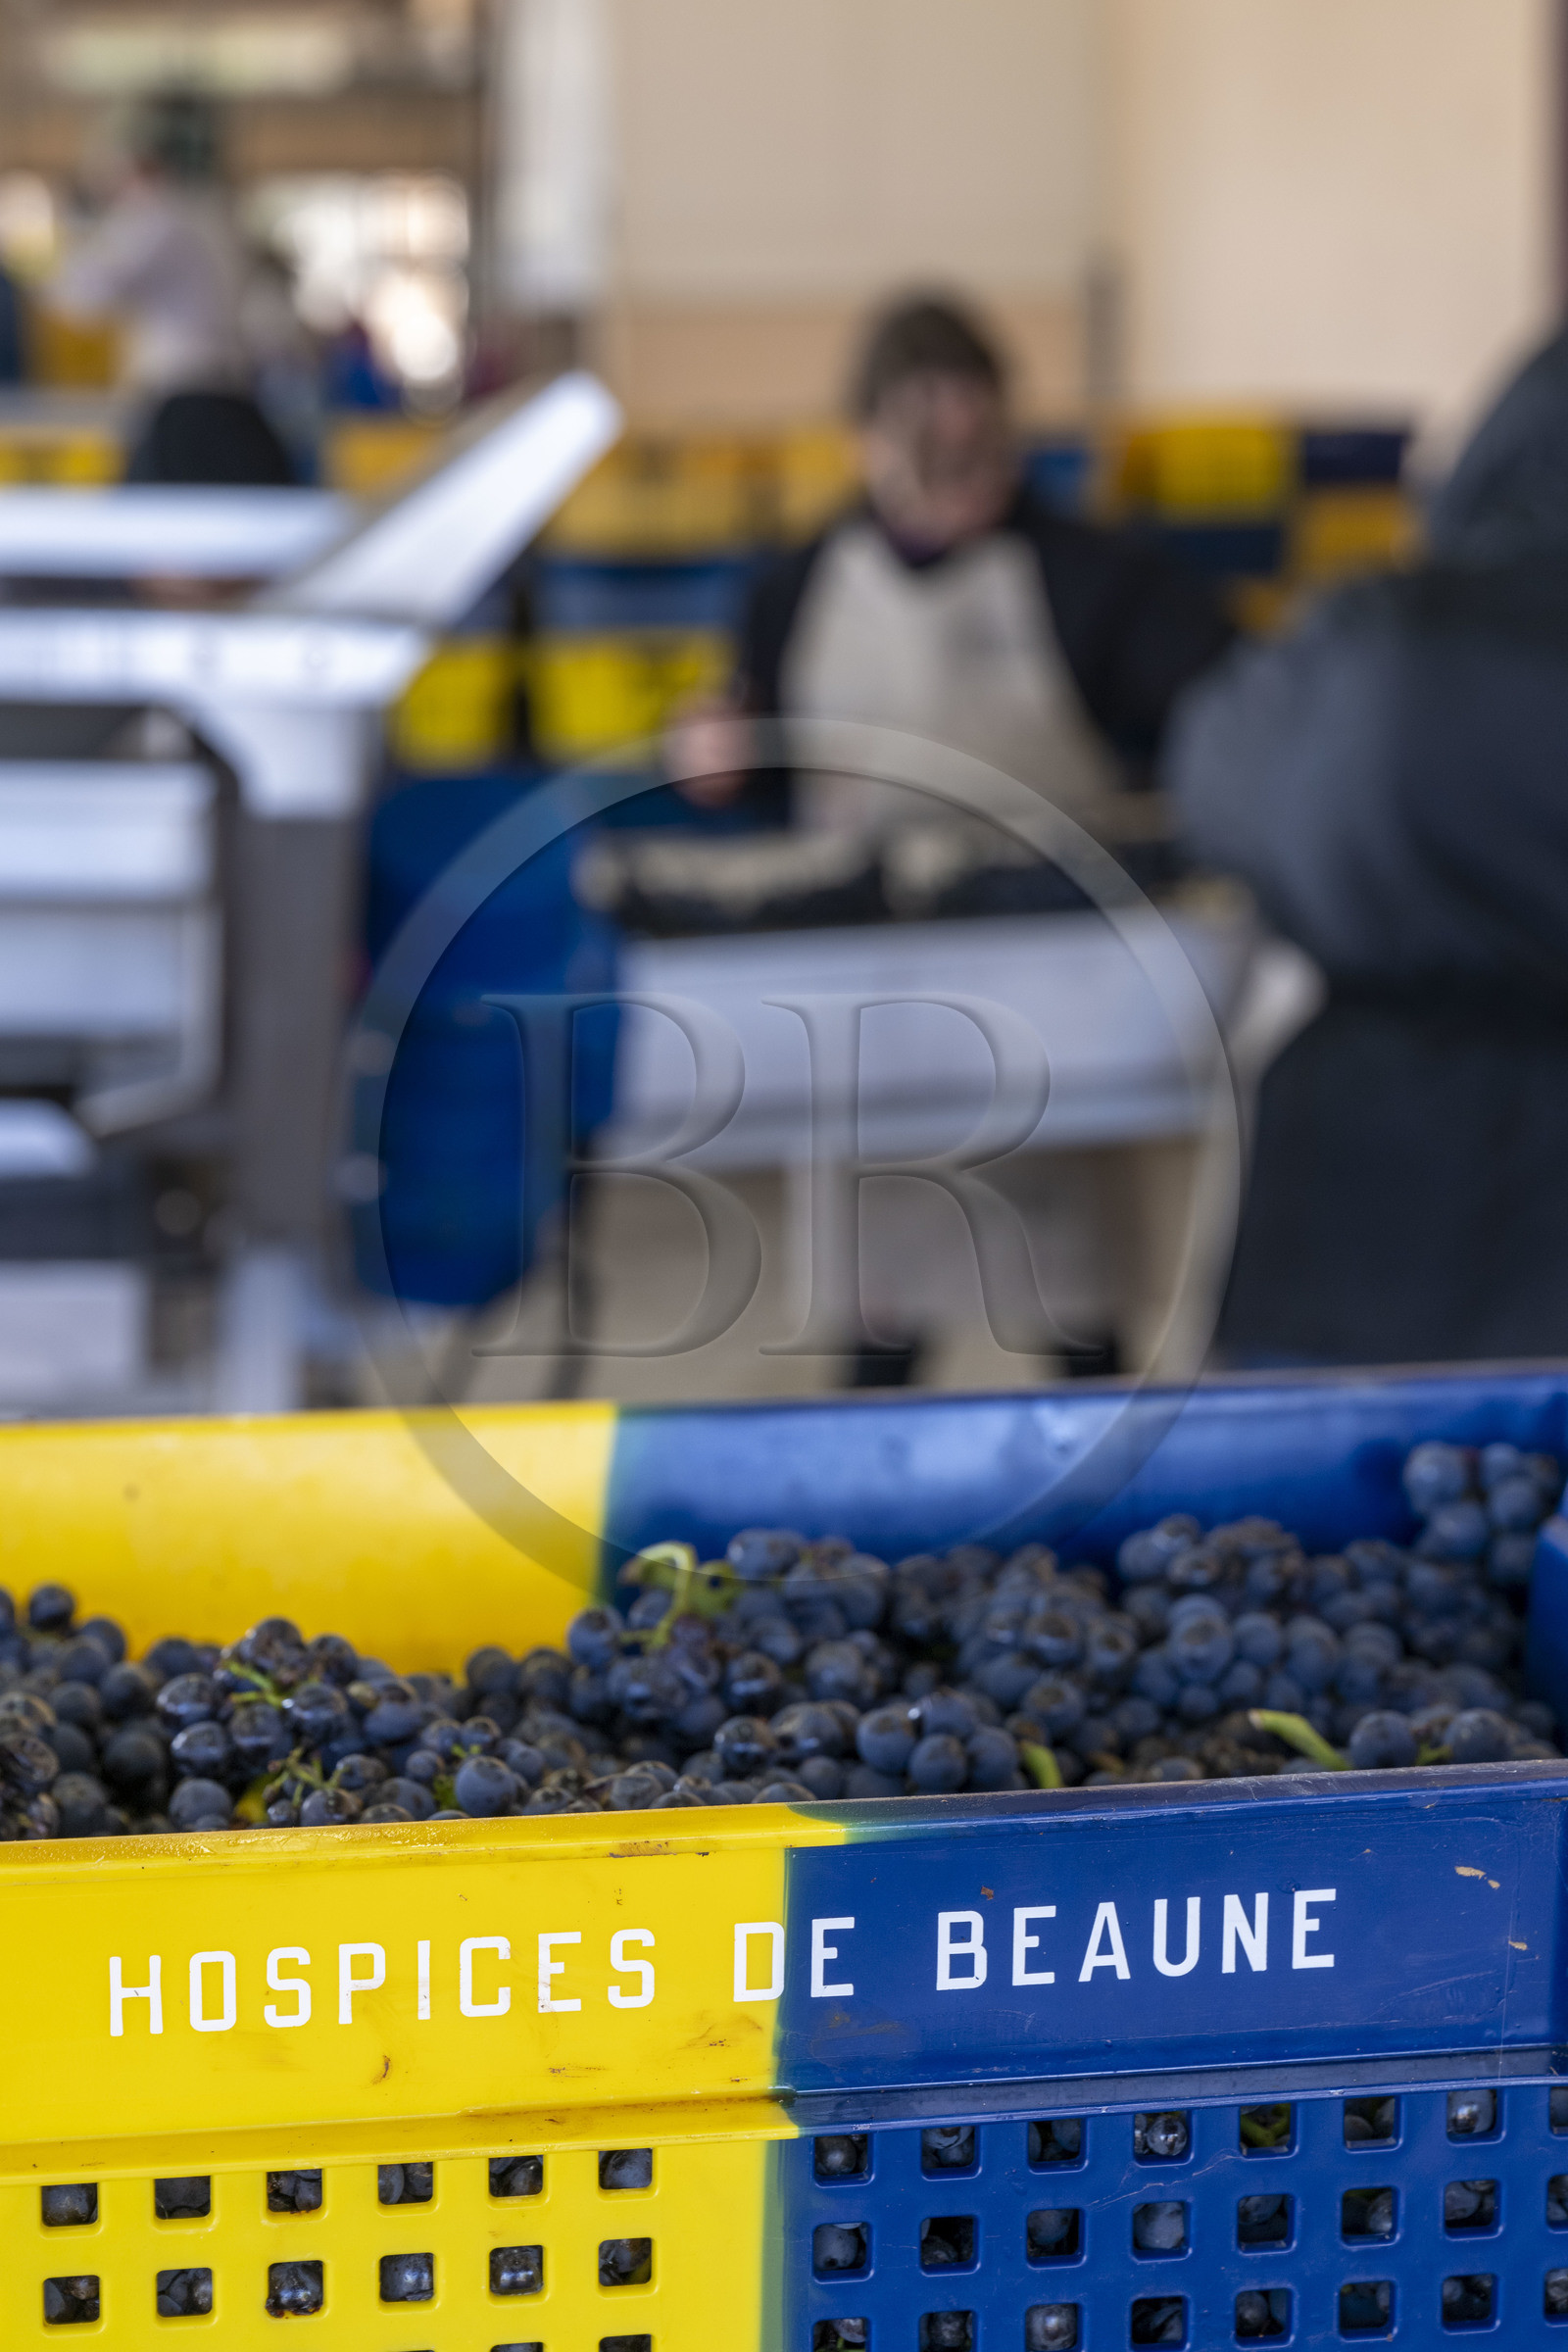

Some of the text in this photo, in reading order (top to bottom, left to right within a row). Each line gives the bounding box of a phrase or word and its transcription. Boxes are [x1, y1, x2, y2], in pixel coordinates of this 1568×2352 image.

[109, 1887, 1337, 2037] HOSPICES DE BEAUNE
